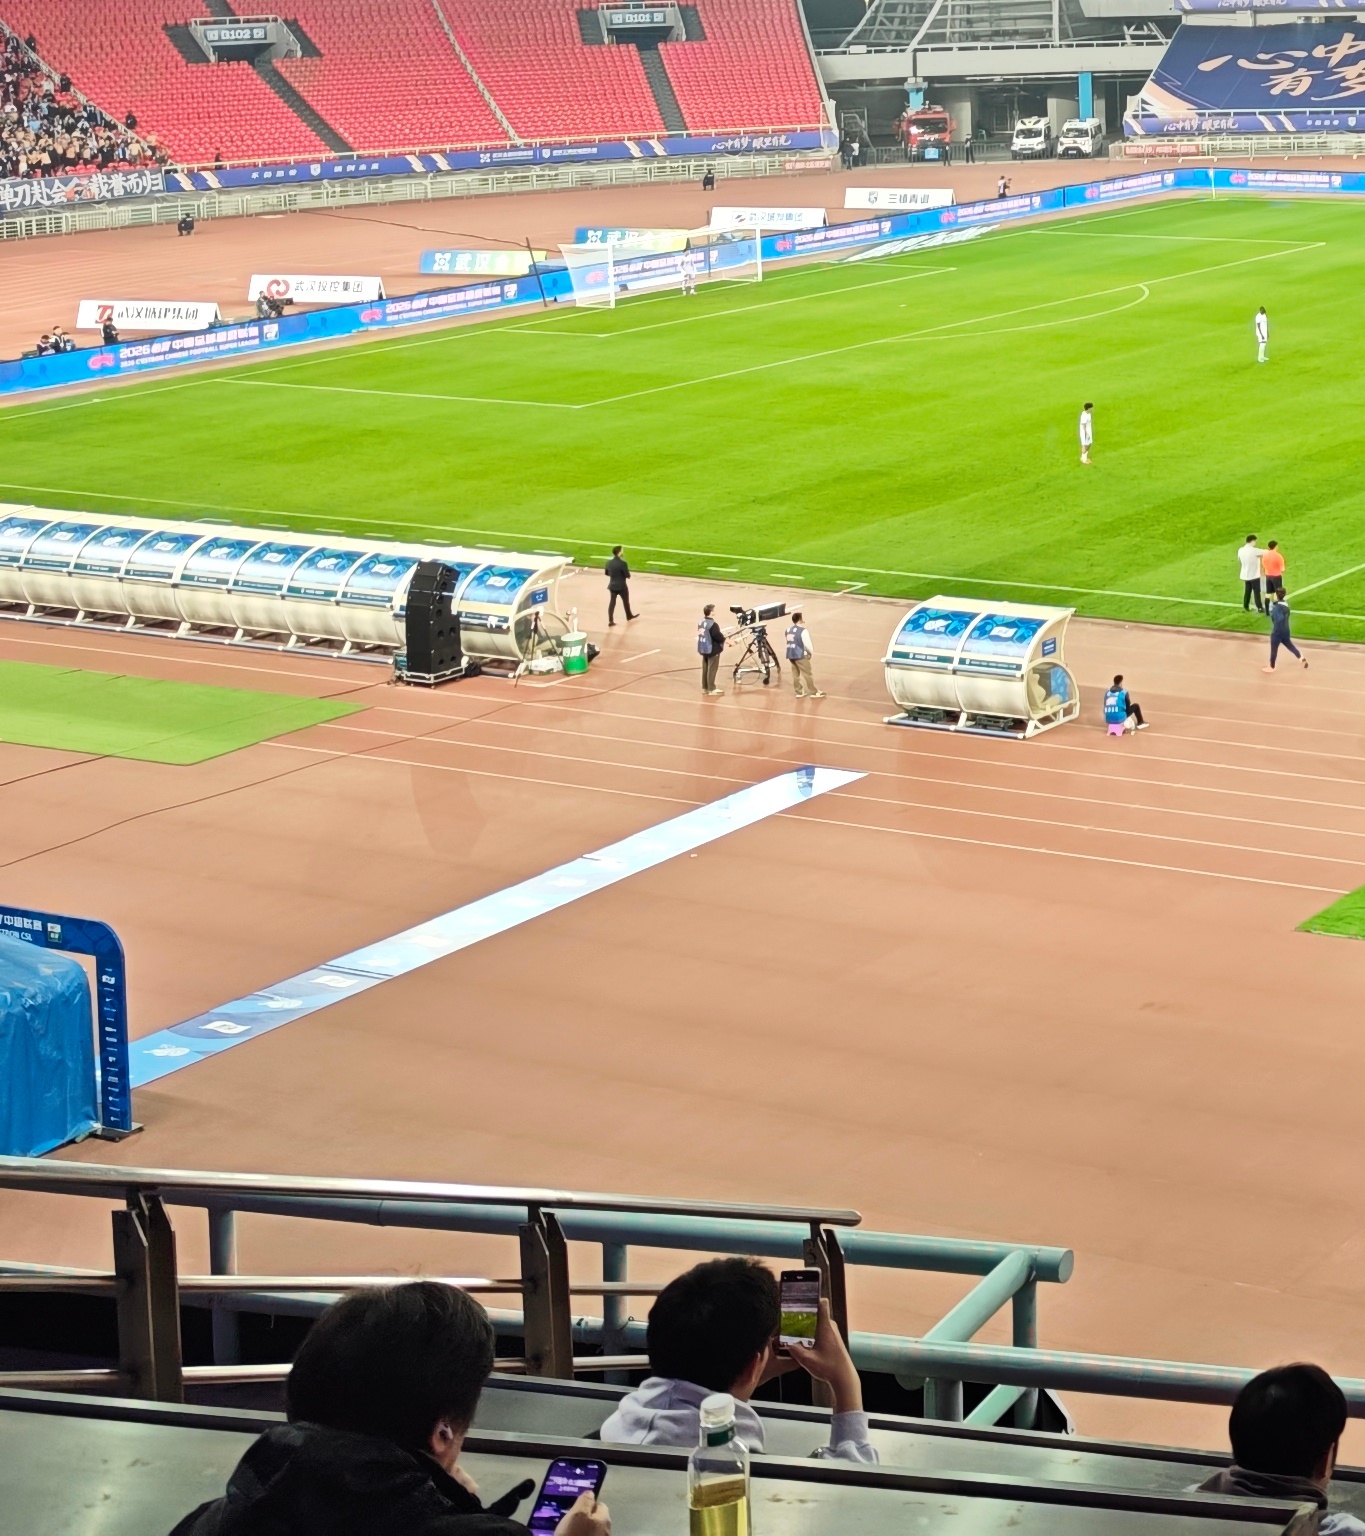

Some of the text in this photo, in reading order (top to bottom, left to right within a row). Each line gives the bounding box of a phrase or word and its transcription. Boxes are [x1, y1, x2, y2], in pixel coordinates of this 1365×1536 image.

[90, 171, 163, 199] 载誉而归
[120, 345, 150, 358] 2026
